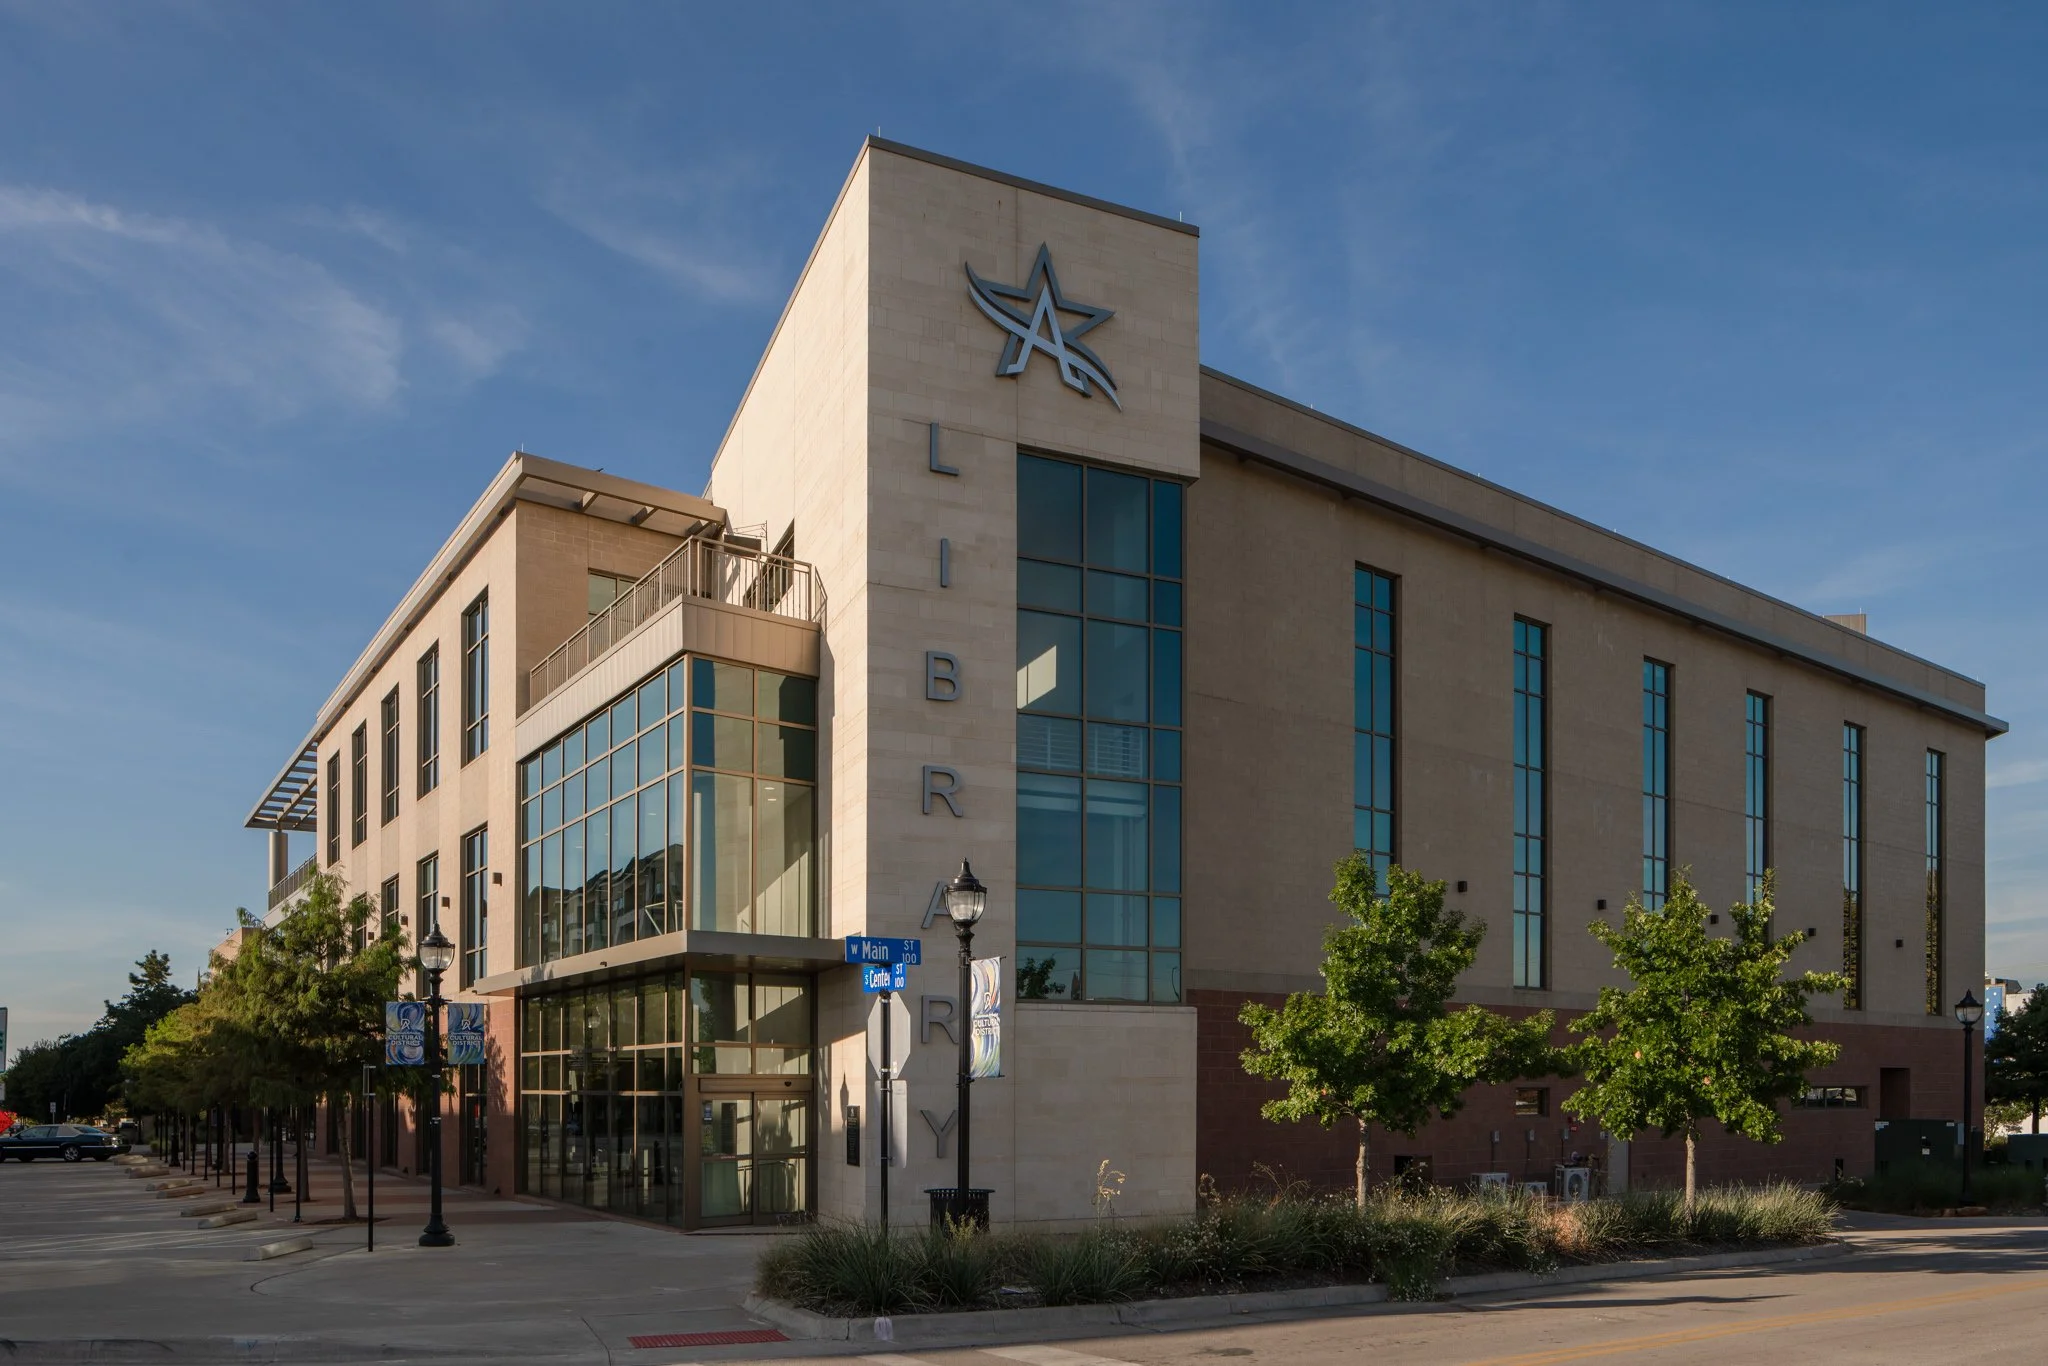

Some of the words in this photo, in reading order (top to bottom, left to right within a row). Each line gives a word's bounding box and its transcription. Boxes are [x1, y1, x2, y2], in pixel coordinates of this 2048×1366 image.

[920, 422, 964, 1158] LIBRARY
[850, 944, 858, 955] W
[862, 940, 889, 960] Main
[903, 940, 915, 951] ST
[902, 952, 917, 964] 100
[864, 974, 869, 985] S
[869, 969, 891, 988] Center
[895, 963, 903, 975] ST
[894, 976, 905, 988] 100
